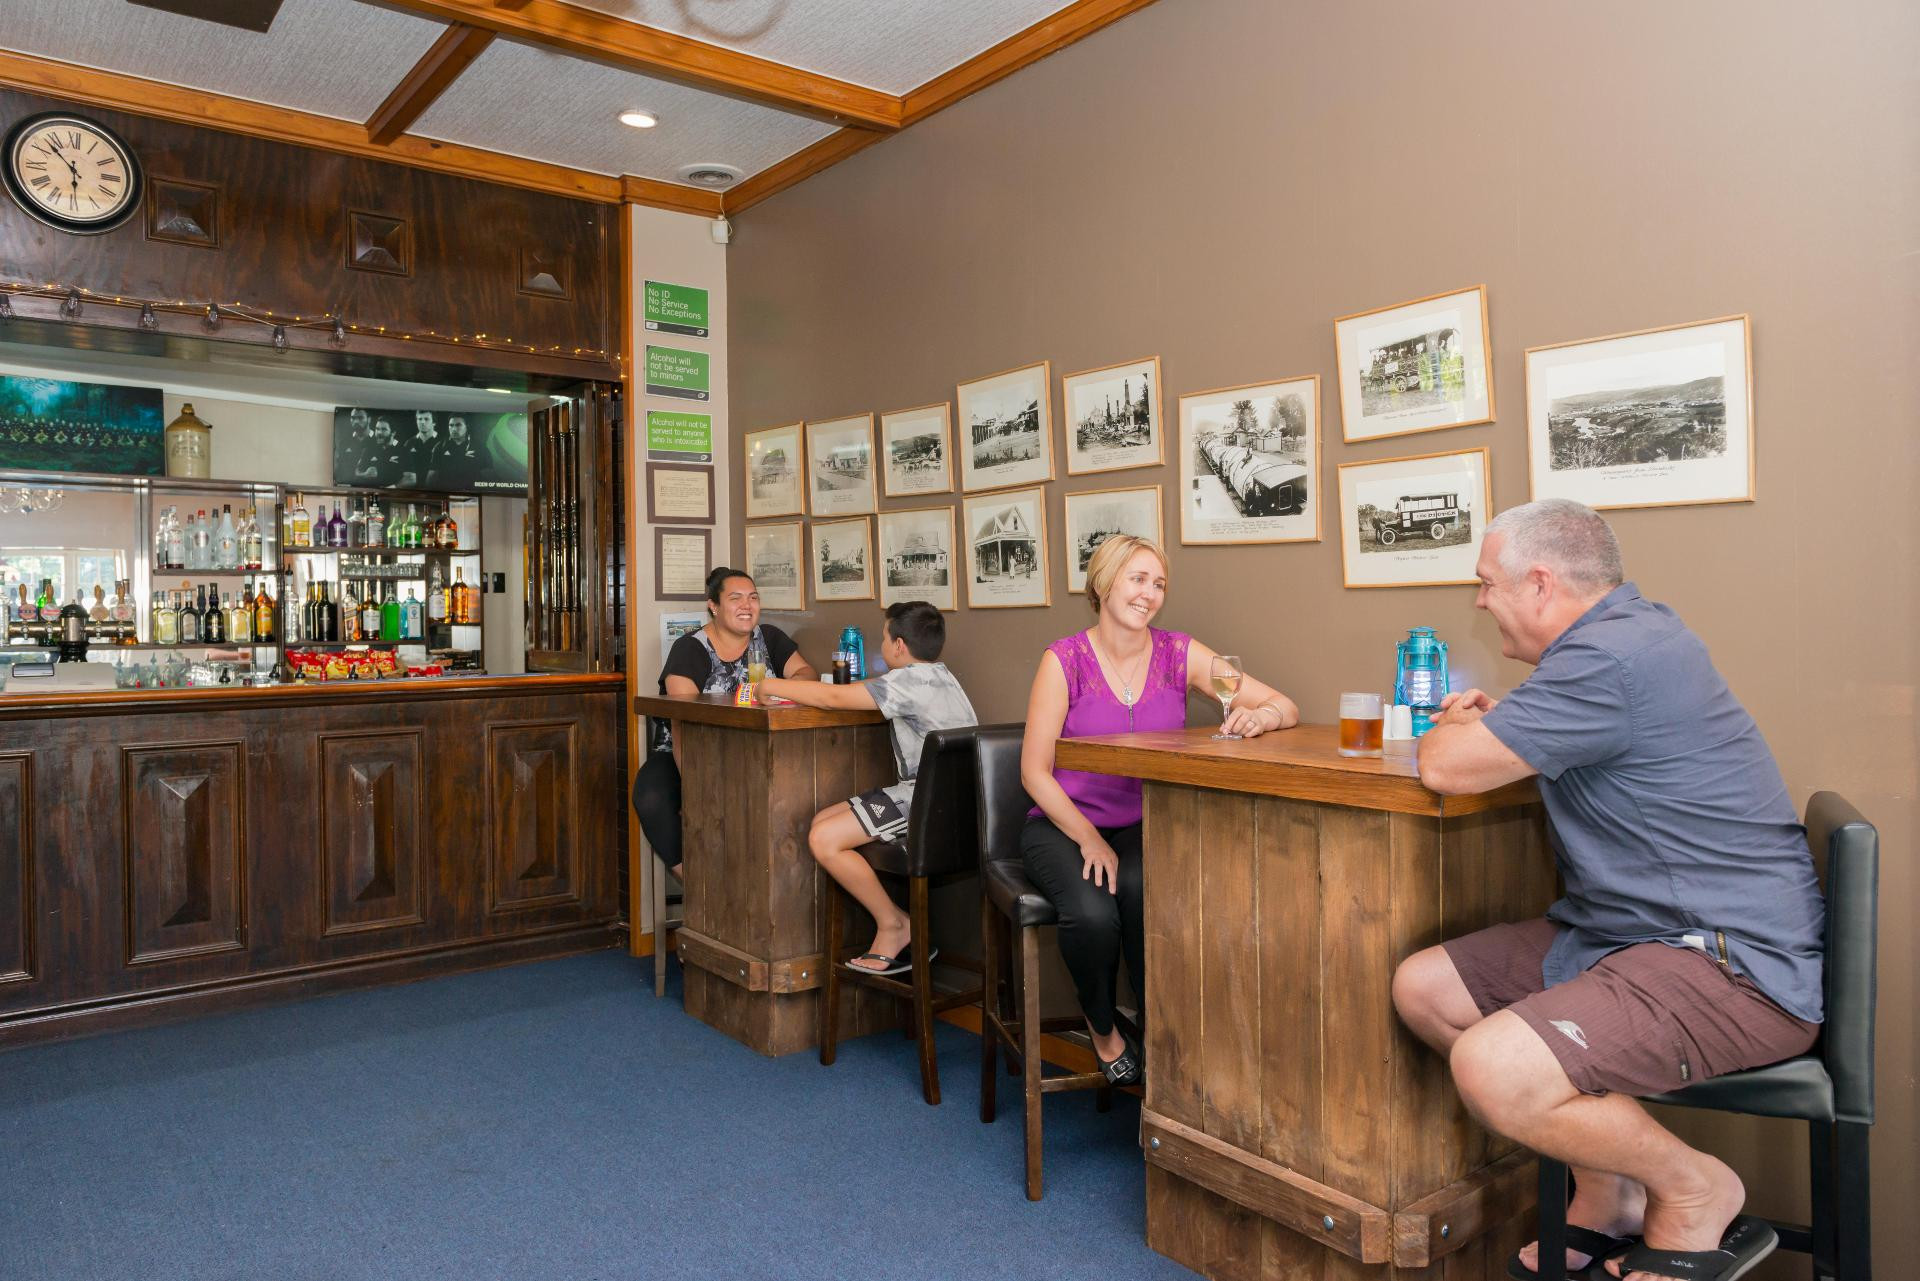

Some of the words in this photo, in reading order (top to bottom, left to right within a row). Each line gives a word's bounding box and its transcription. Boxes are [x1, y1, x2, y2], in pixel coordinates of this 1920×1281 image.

[649, 288, 659, 297] No
[662, 290, 671, 298] ID
[649, 296, 659, 305] No
[662, 298, 688, 310] Service
[649, 305, 659, 313] No
[662, 307, 701, 320] Exceptions
[651, 352, 677, 364] Alcohol
[679, 357, 691, 366] will
[651, 362, 662, 370] not
[664, 364, 673, 372] be
[675, 367, 699, 375] served
[650, 370, 658, 378] to
[660, 371, 684, 382] minors
[651, 418, 675, 427] Alcohol
[699, 421, 708, 429] be
[682, 430, 704, 438] anyone
[674, 438, 708, 446] intoxicated
